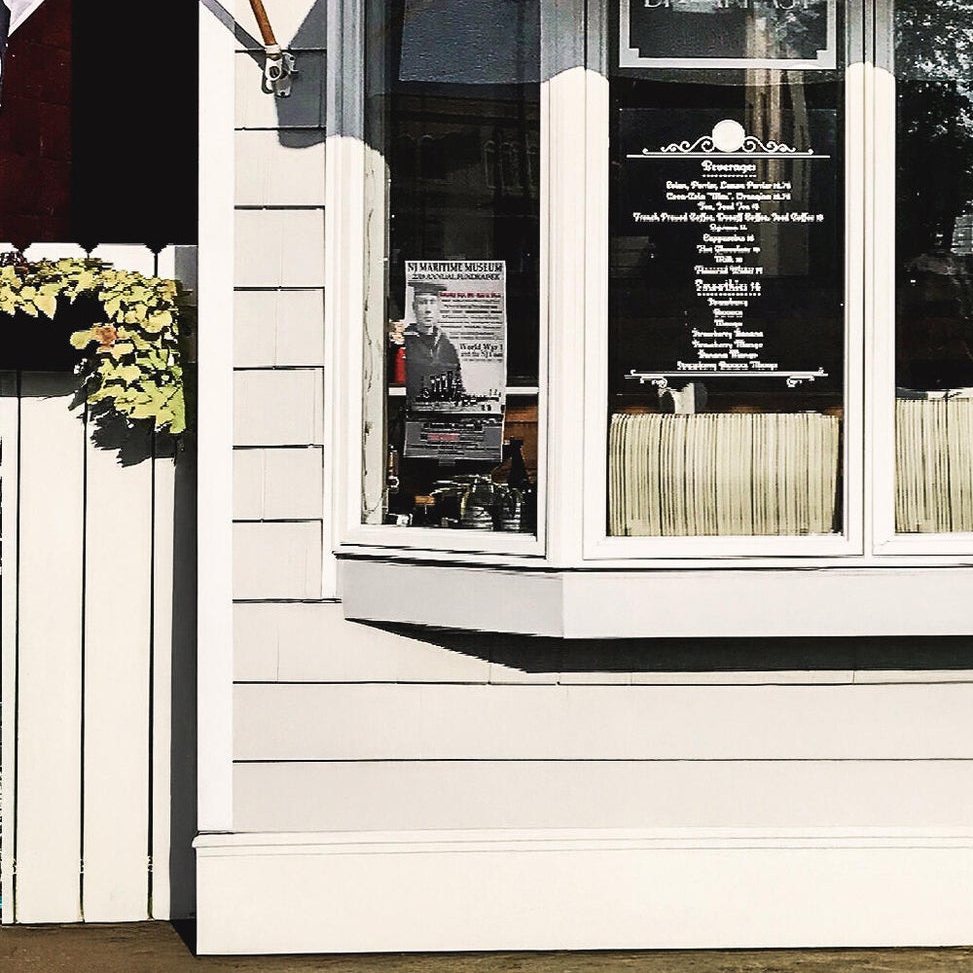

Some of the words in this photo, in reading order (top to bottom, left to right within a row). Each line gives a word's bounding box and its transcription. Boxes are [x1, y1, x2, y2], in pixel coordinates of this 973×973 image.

[701, 160, 756, 173] Beverages
[420, 262, 463, 272] MARITIME
[465, 262, 502, 272] MUSEUM
